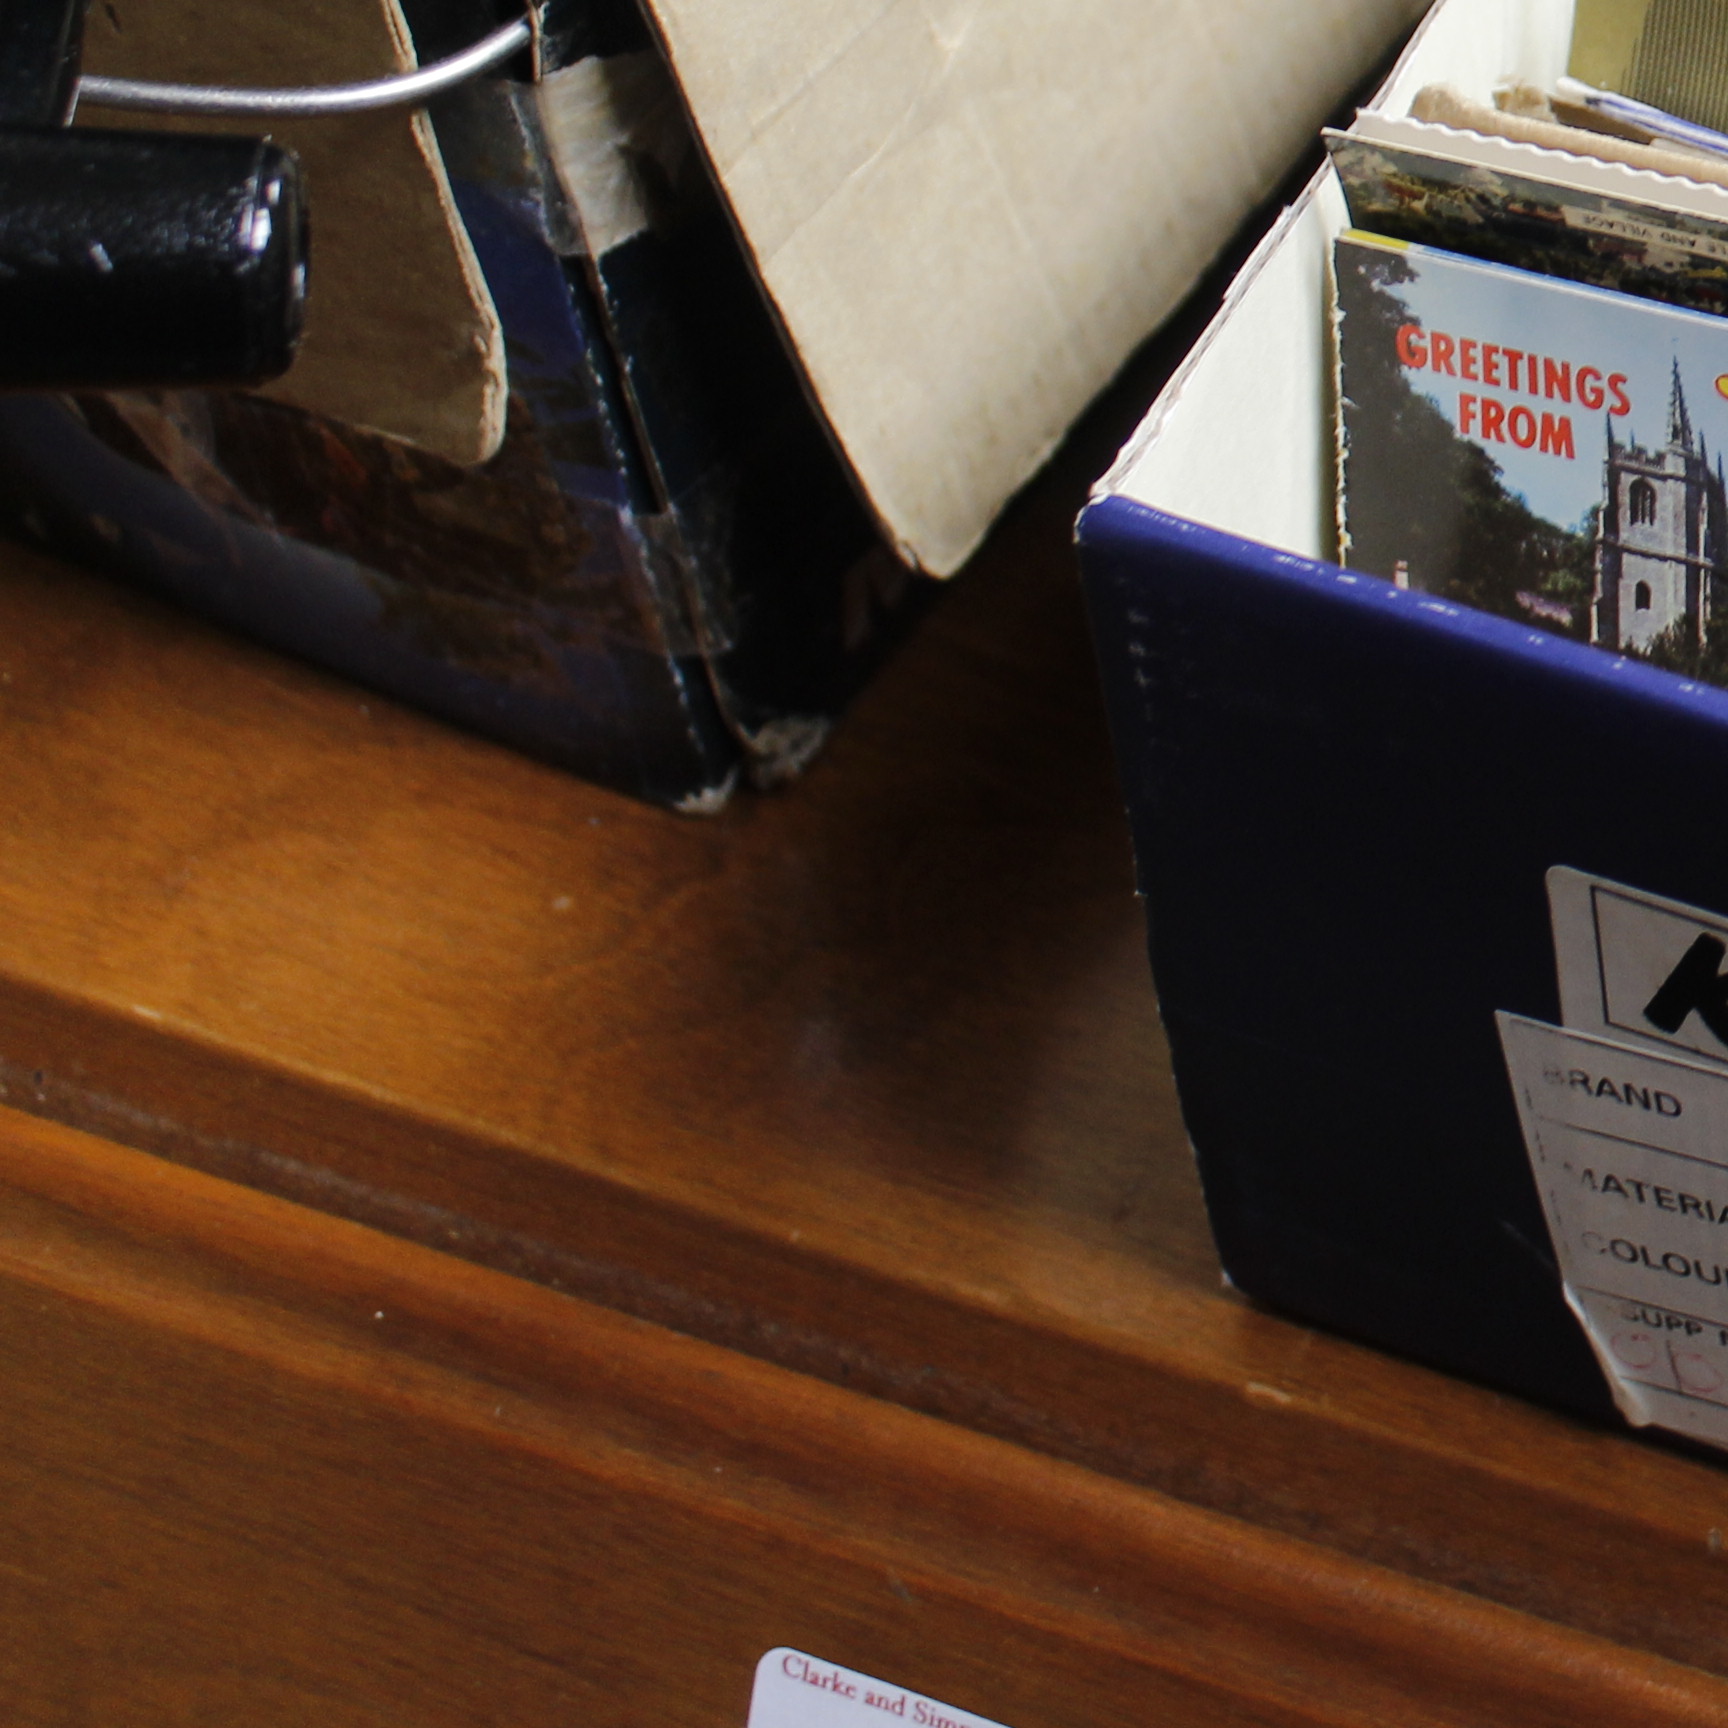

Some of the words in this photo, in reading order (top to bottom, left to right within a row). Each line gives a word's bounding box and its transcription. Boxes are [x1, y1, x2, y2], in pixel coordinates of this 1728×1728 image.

[1582, 213, 1652, 238] VILLAGE
[1660, 229, 1698, 248] AND
[1396, 324, 1632, 416] GREETINGS
[1459, 393, 1577, 461] FROM
[780, 1653, 858, 1699] Clarke
[864, 1688, 907, 1718] and
